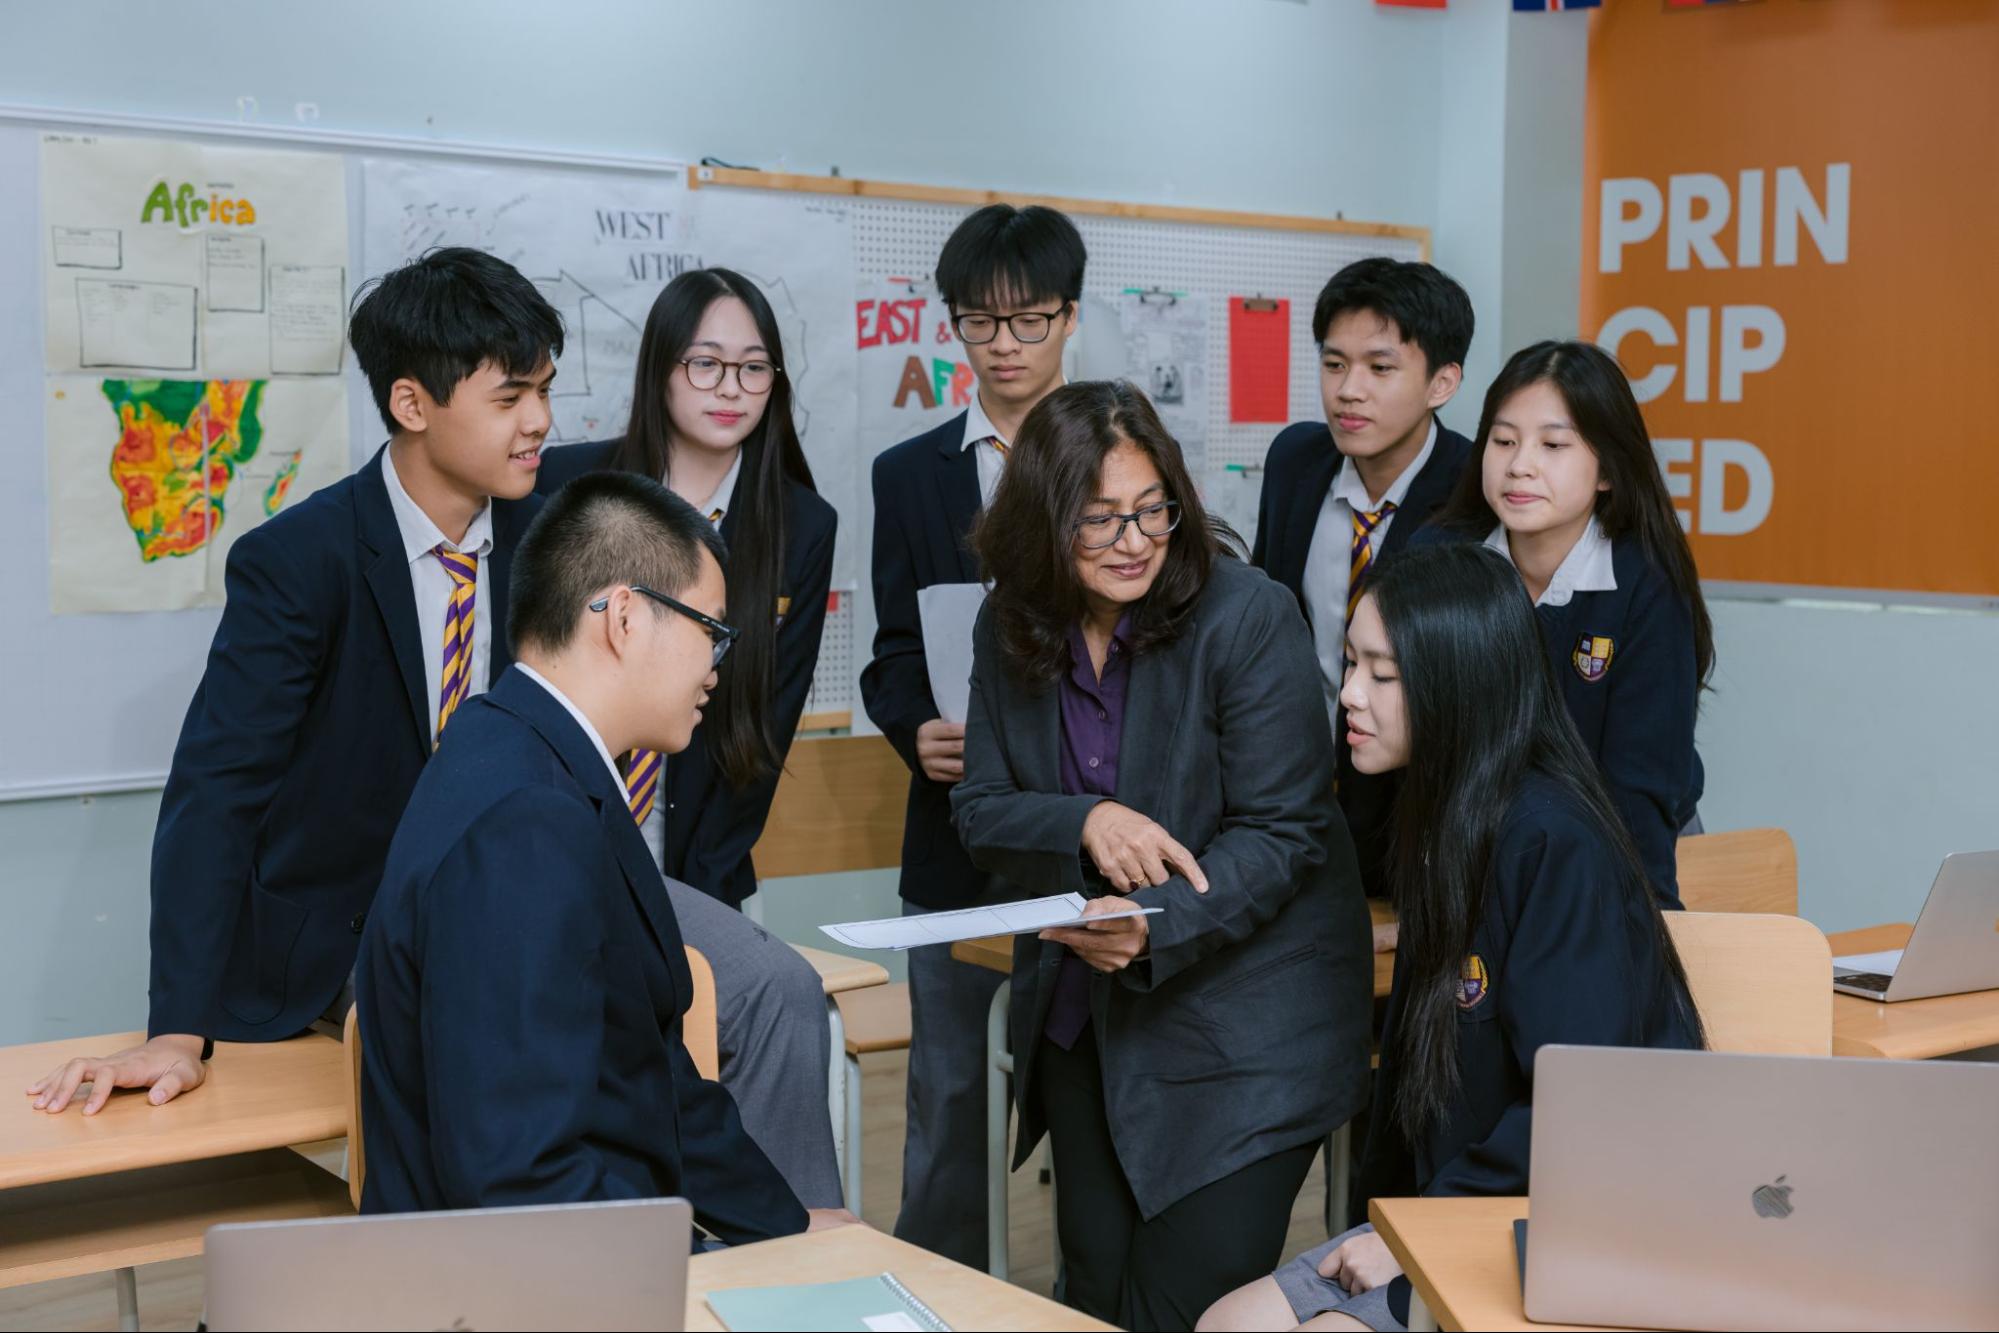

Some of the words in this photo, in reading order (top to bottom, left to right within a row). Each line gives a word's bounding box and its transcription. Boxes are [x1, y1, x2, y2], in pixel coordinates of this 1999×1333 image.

[140, 181, 256, 228] Africa
[595, 209, 671, 240] WEST
[1599, 162, 1851, 274] PRIN
[856, 297, 928, 351] EAST
[936, 321, 952, 344] &
[1596, 305, 1787, 403] CIP
[1650, 437, 1775, 537] ED
